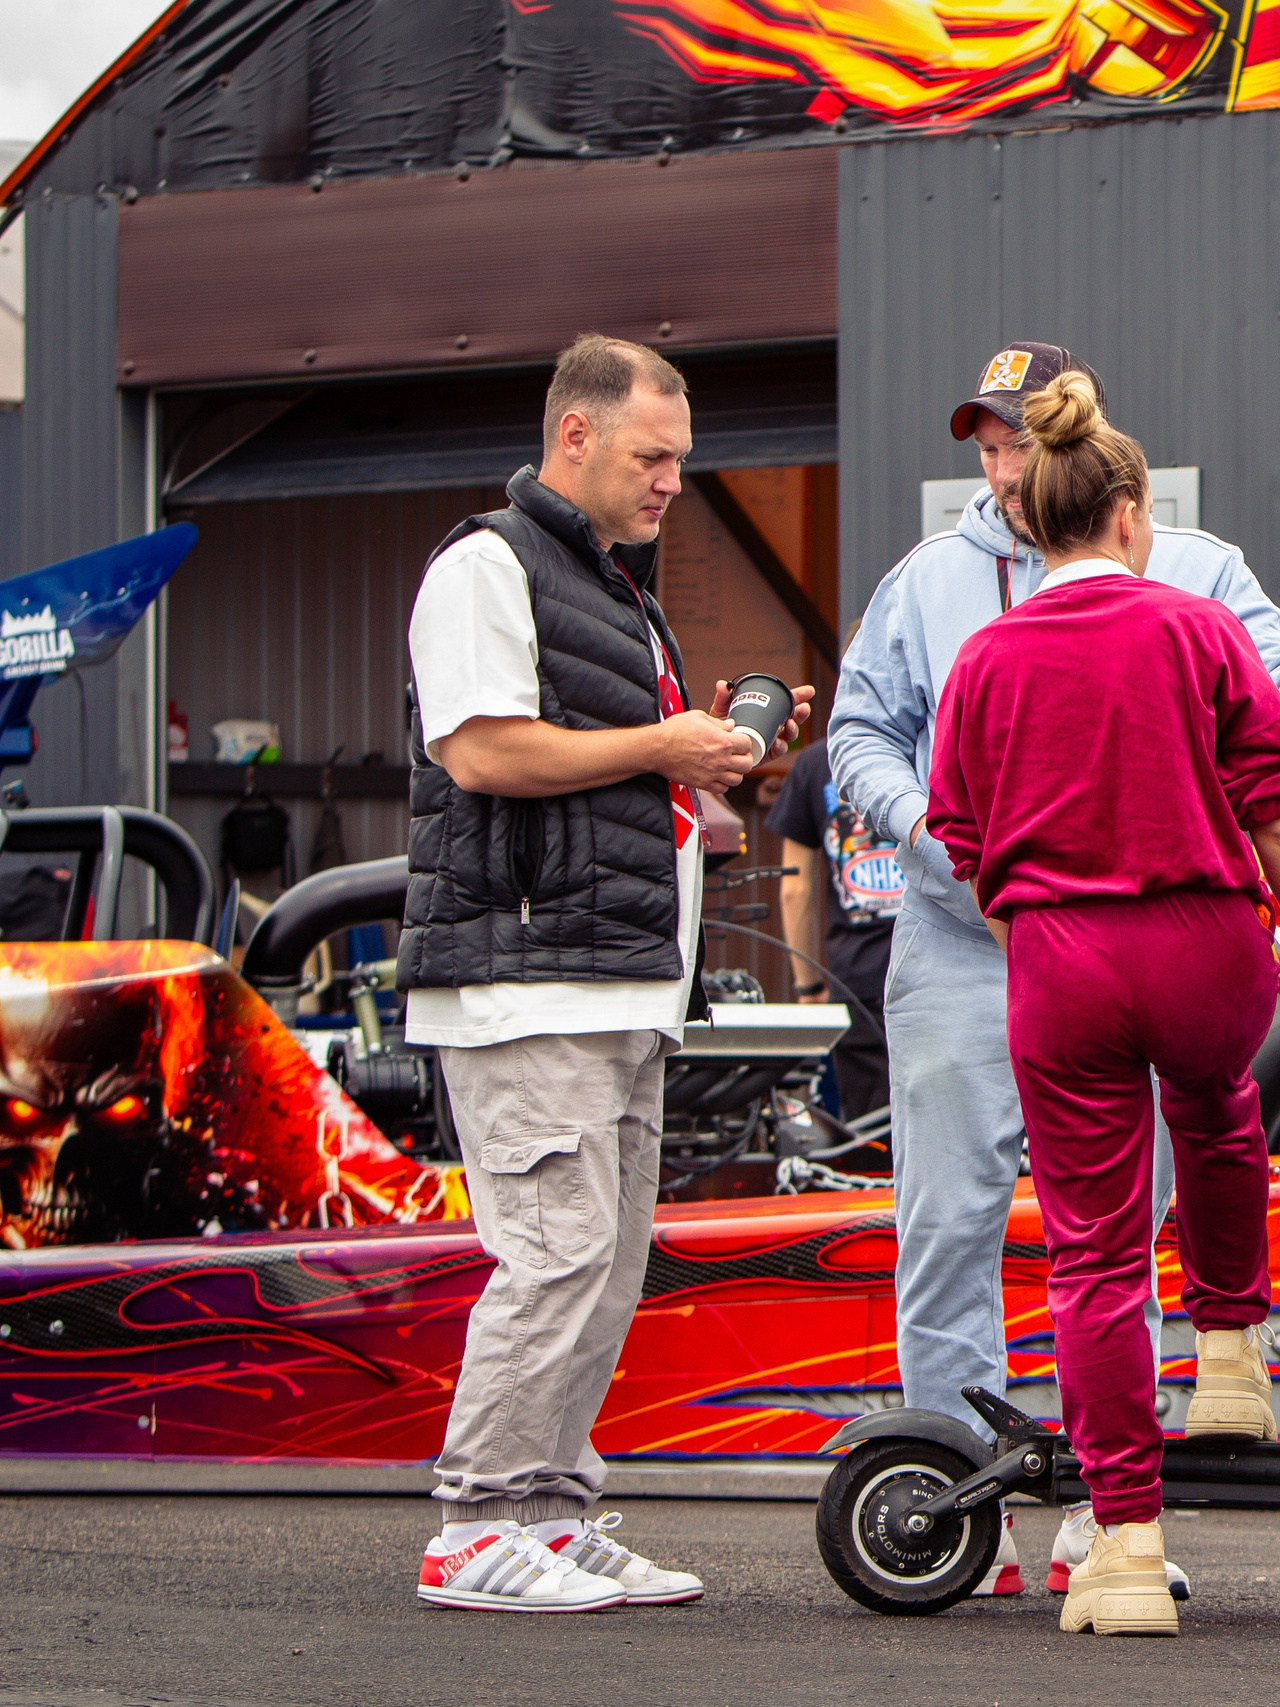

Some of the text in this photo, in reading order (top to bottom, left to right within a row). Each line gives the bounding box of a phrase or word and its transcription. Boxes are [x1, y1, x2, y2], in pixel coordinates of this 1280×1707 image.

[850, 857, 905, 890] NHR
[912, 1488, 934, 1500] SINC
[959, 1480, 998, 1504] DUALTRON
[877, 1503, 932, 1561] MINIMOTORS
